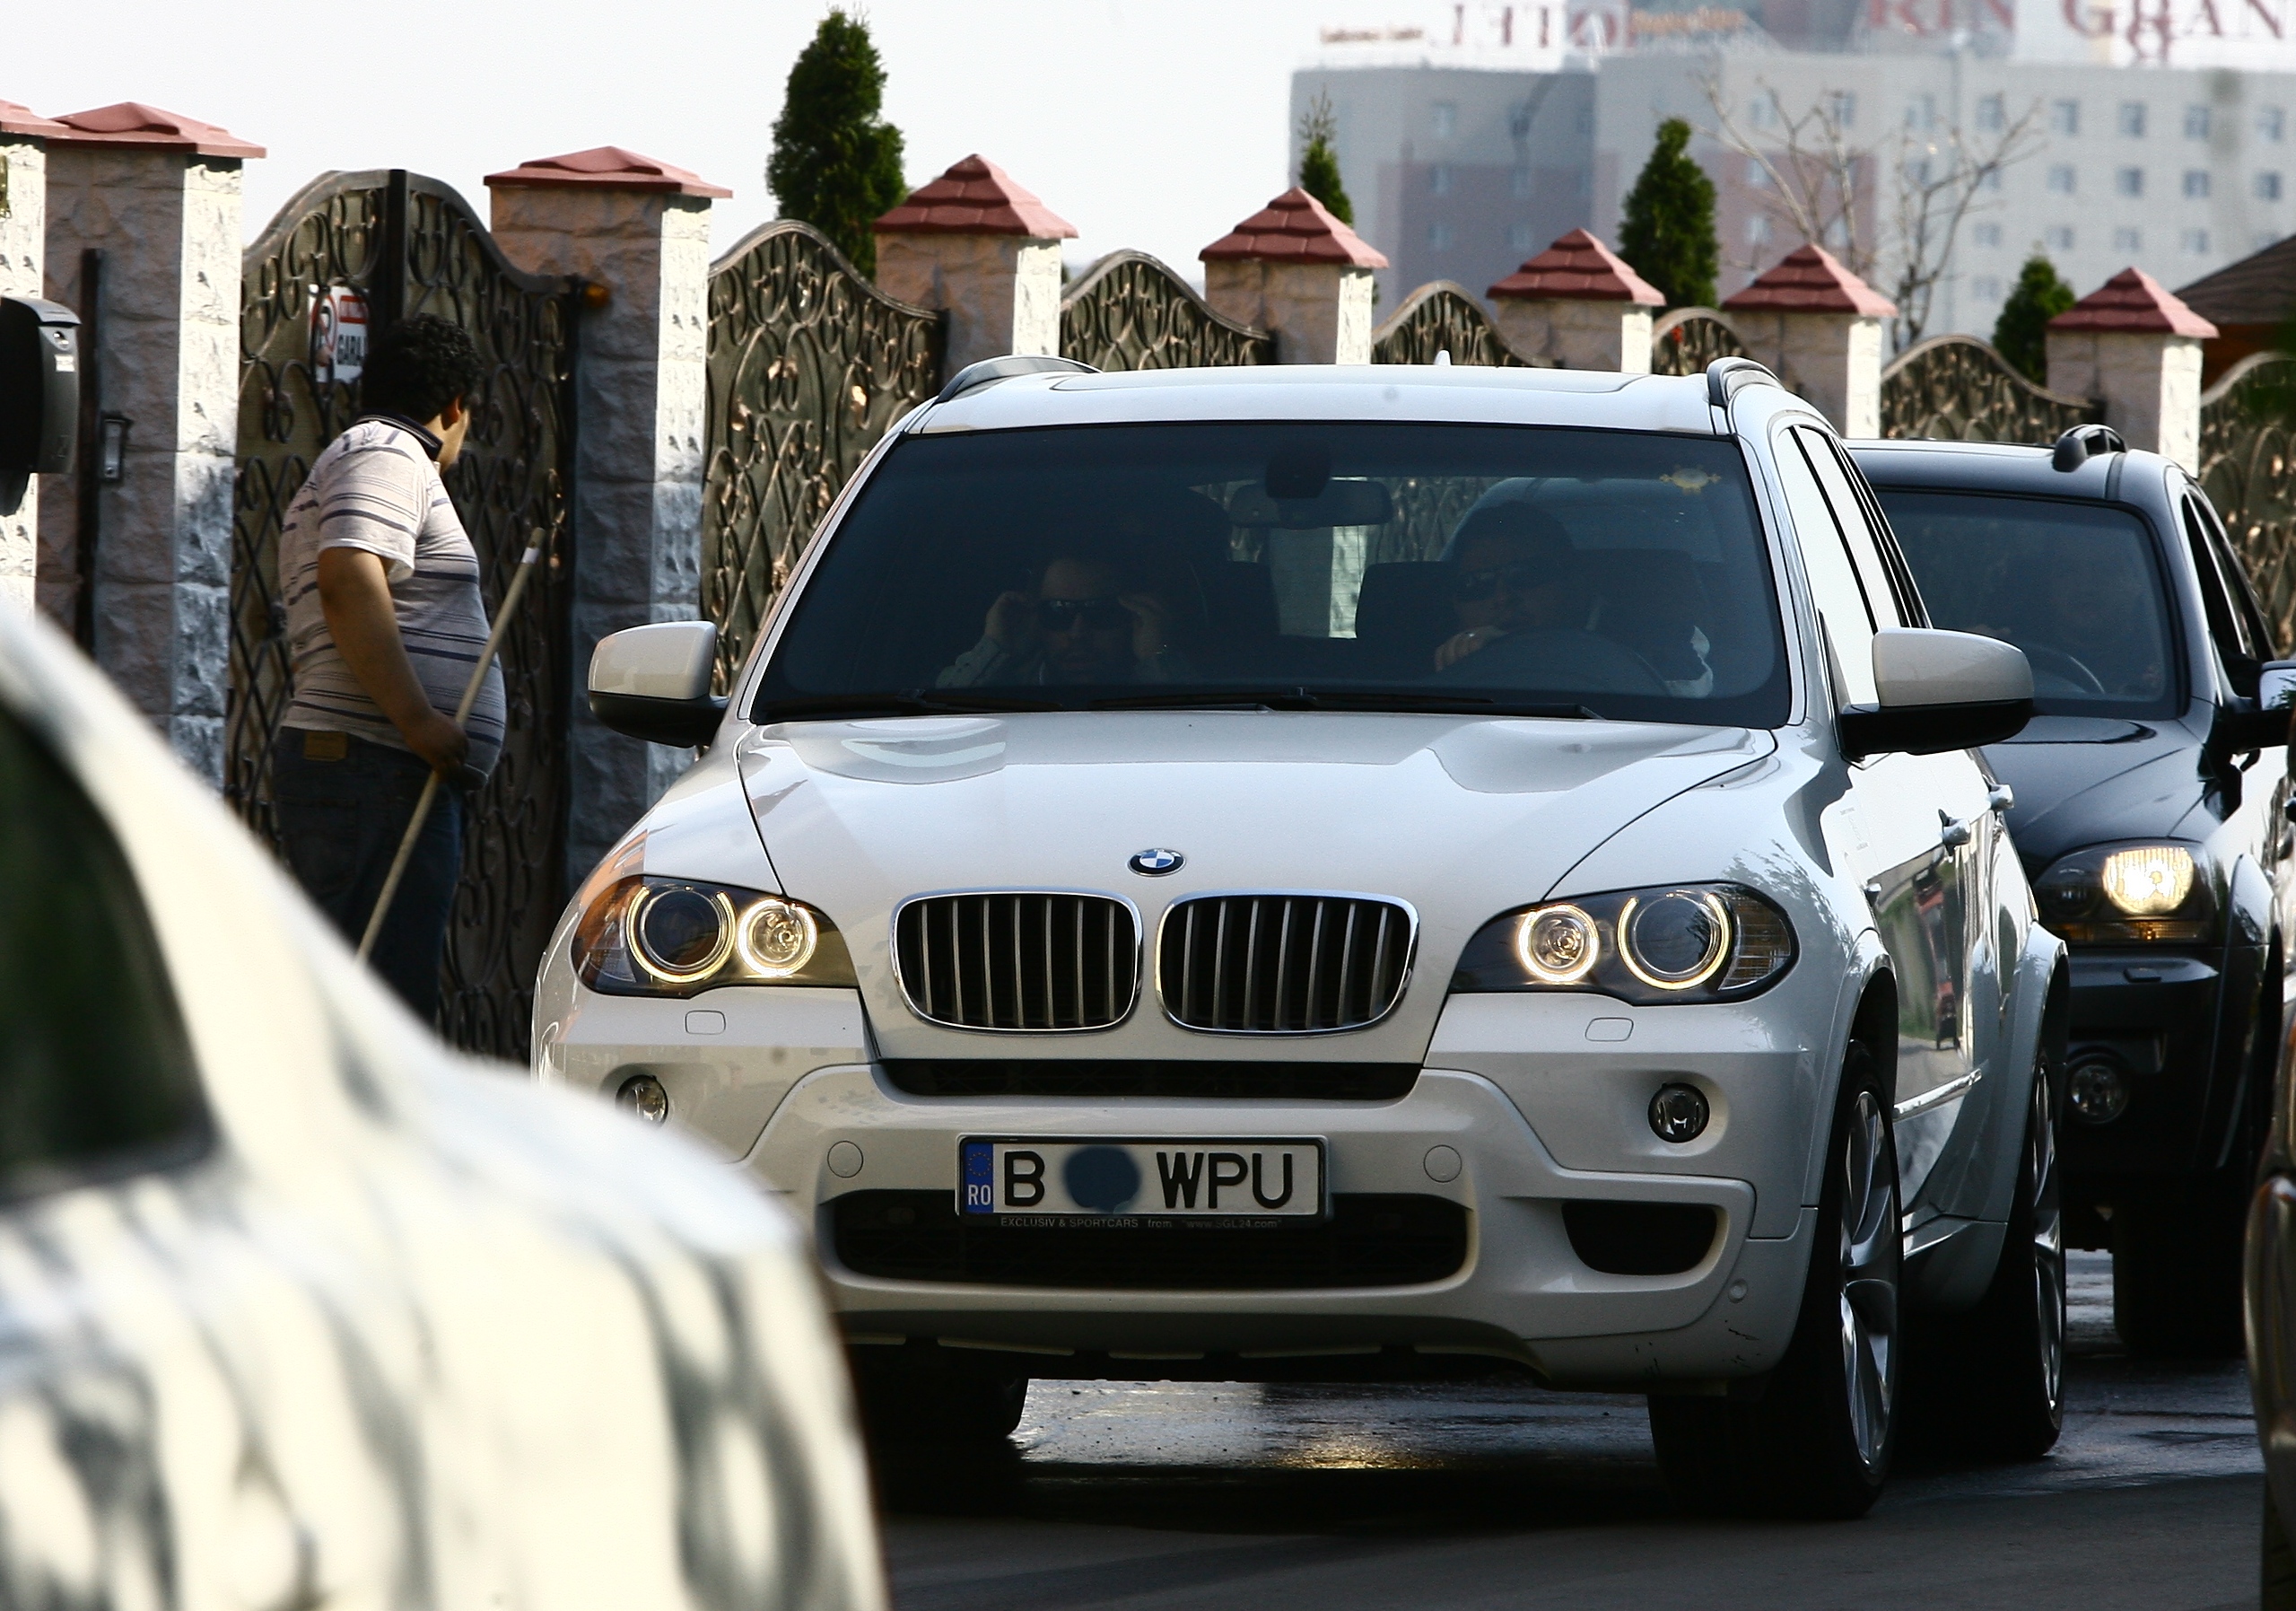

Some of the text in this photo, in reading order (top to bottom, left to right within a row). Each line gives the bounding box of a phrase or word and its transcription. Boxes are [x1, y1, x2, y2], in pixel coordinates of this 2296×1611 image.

[1003, 1150, 1294, 1209] B WPU
[967, 1184, 992, 1206] RO
[1000, 1217, 1056, 1228] EXCLUSIV
[1059, 1217, 1066, 1228] &
[1069, 1217, 1139, 1229] SPORTCARS
[1147, 1218, 1173, 1229] from
